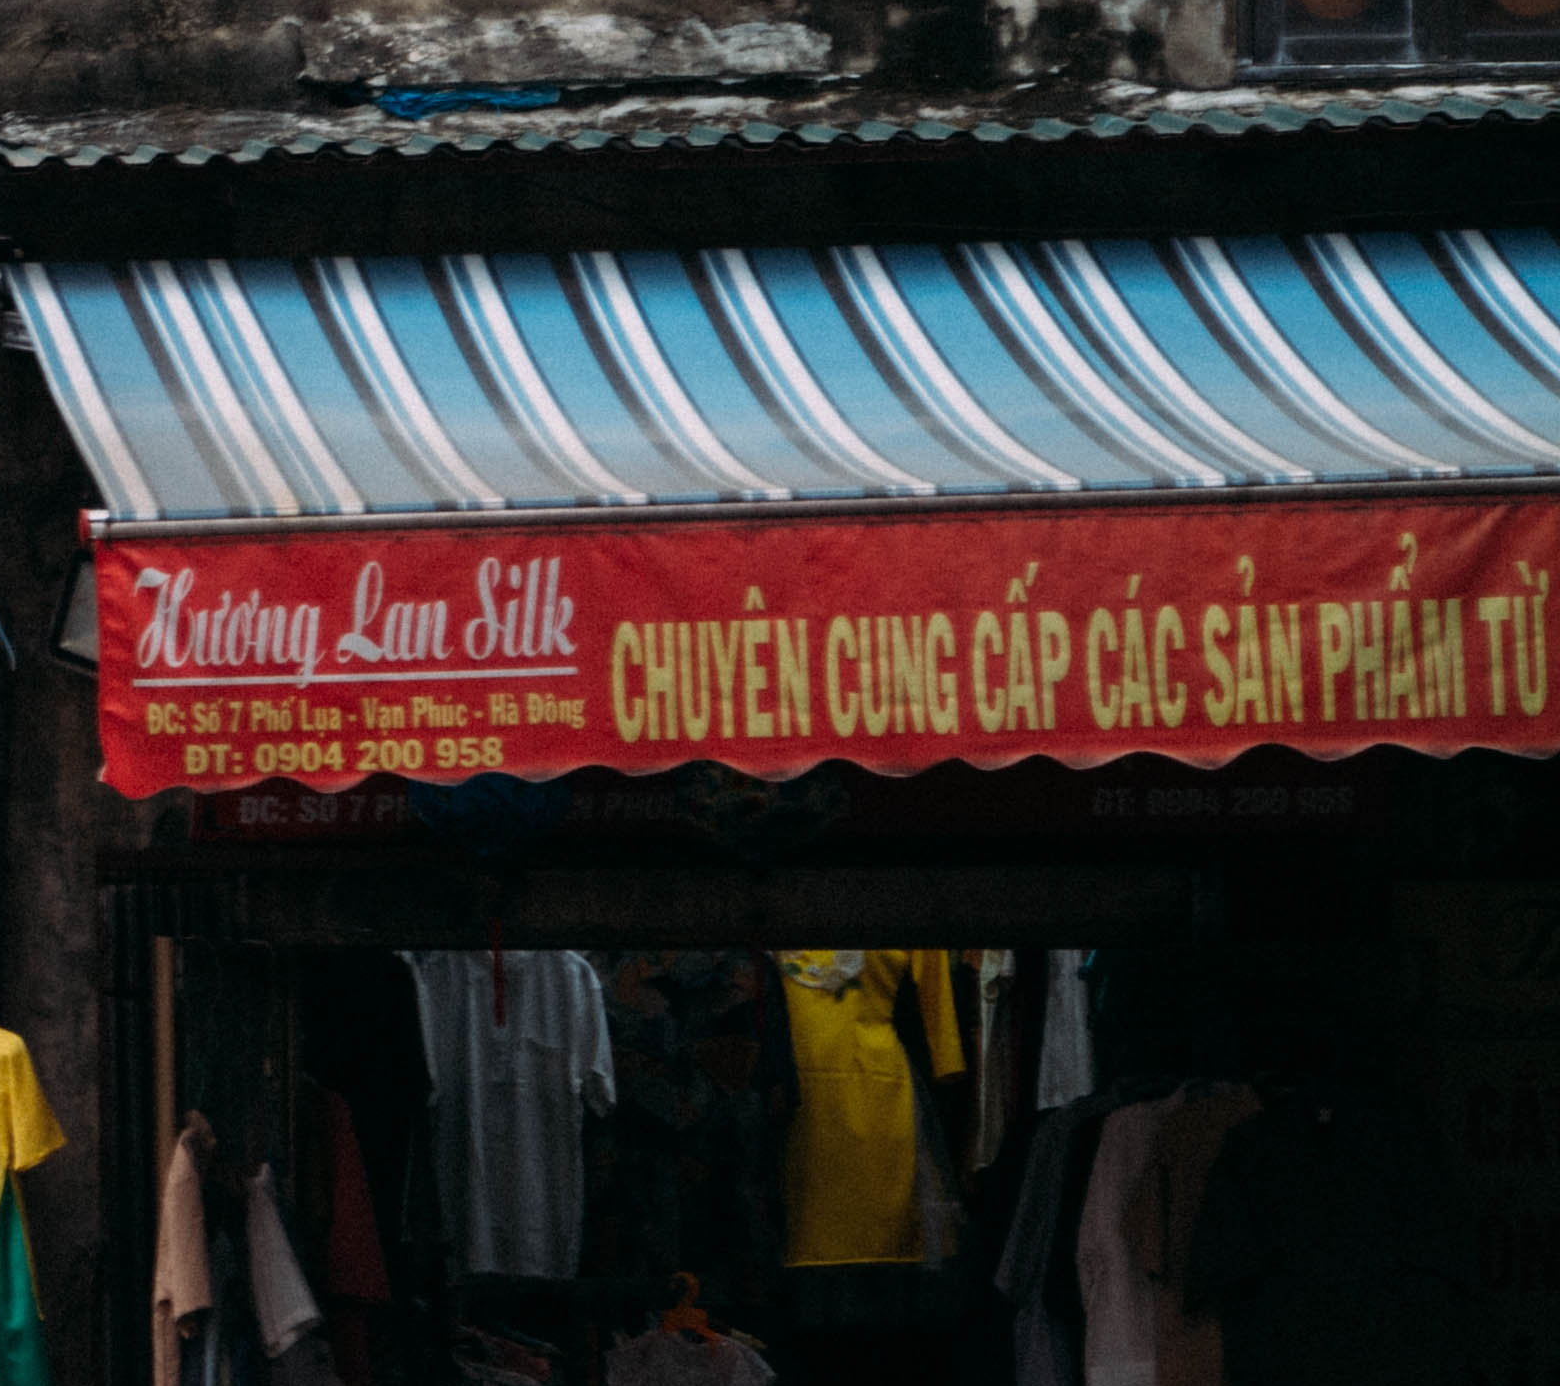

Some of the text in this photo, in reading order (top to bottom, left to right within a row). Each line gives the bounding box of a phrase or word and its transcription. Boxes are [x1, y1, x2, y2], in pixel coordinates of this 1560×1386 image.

[132, 557, 577, 688] Hương Lan Silk
[611, 531, 1550, 743] CHUYÊN CUNG CẤP CÁC SẢN PHẨM TỪ
[184, 736, 505, 775] ĐT: 0904 200 958
[229, 701, 243, 732] 7
[250, 695, 293, 732] Phố
[300, 700, 343, 739] Lụa
[361, 697, 406, 736] Vạn
[412, 693, 469, 729] Phúc
[488, 692, 520, 726] Hà
[527, 692, 587, 730] Đông
